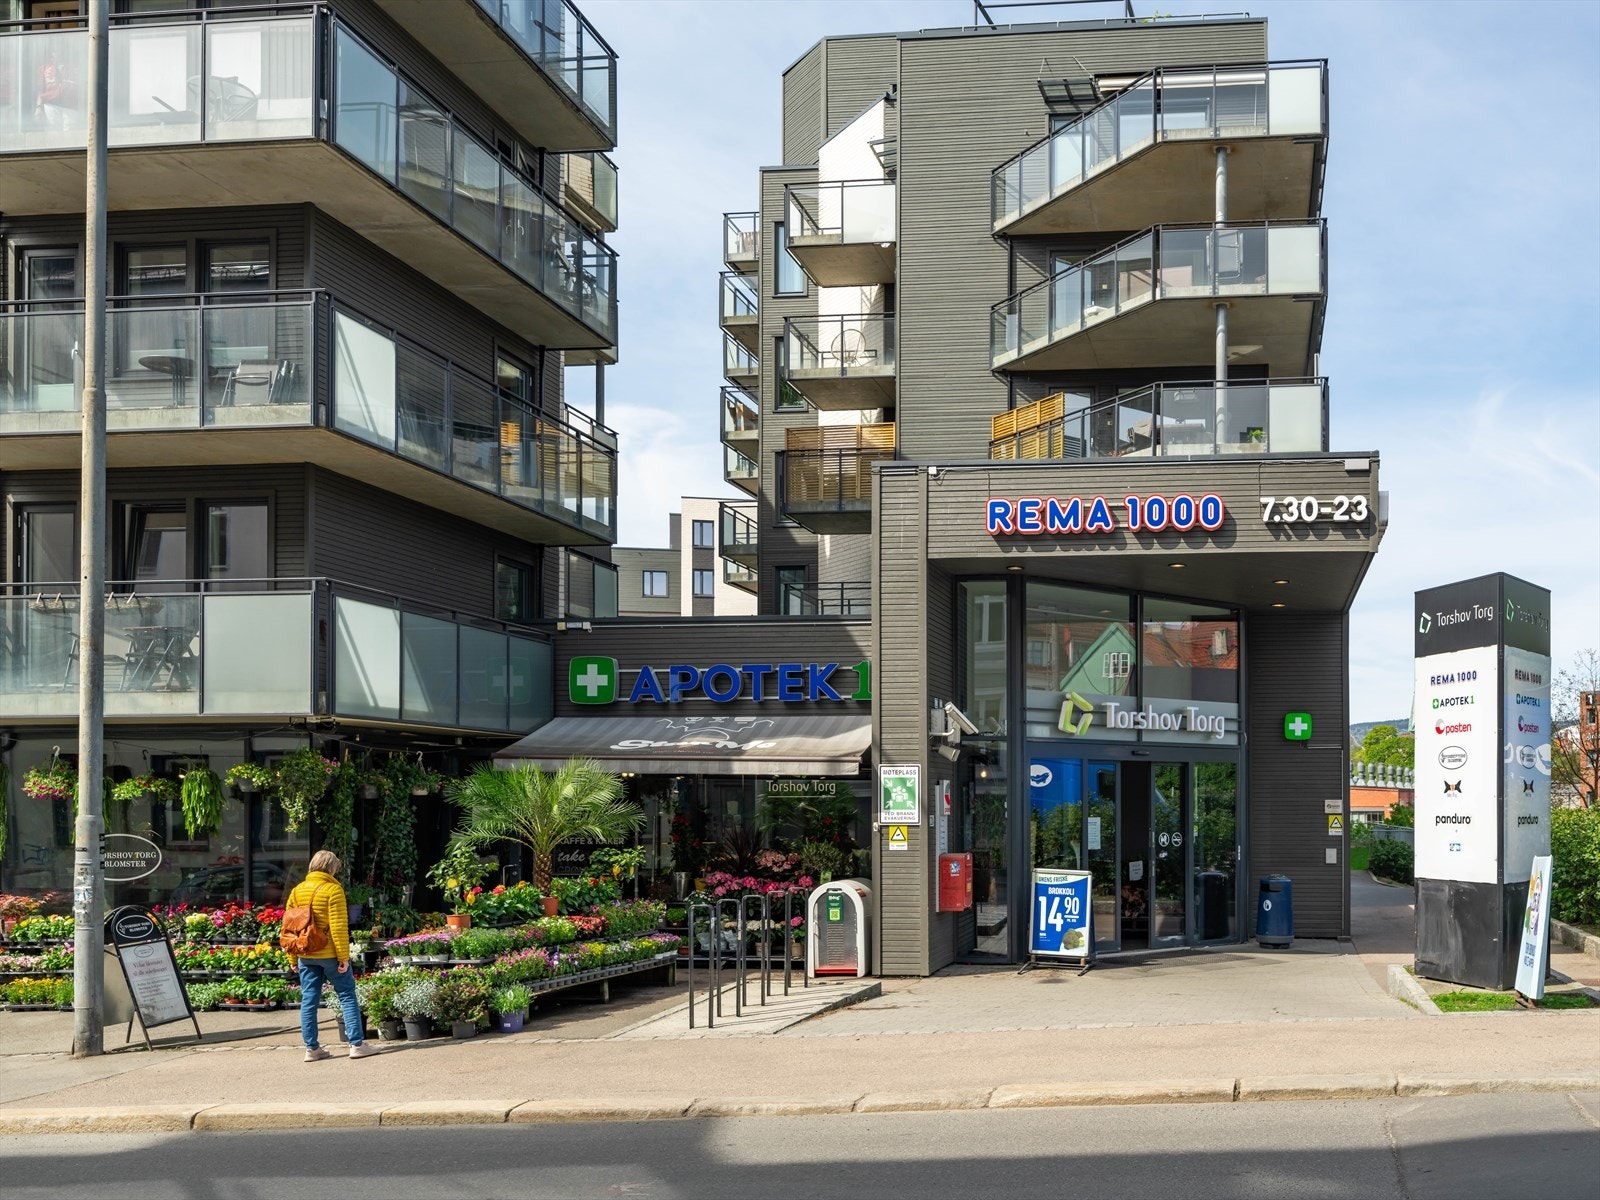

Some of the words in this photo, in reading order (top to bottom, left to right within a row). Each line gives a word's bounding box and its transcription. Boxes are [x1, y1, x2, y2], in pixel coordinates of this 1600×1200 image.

[985, 496, 1114, 535] REMA
[1124, 492, 1224, 533] 1000
[1260, 495, 1369, 522] 7.30-23
[1436, 609, 1472, 627] Torshov
[1473, 604, 1494, 622] Torg
[628, 662, 848, 703] APOTEK
[851, 660, 872, 701] 1
[1430, 674, 1455, 686] REMA
[1457, 670, 1477, 682] 1000
[1514, 668, 1530, 682] REMA
[1530, 673, 1542, 686] 1000
[1439, 696, 1469, 707] APOTEK
[1470, 695, 1475, 704] 1
[1520, 695, 1537, 707] APOTEK
[1102, 702, 1183, 731] Torshov
[1186, 706, 1225, 739] Torg
[1445, 722, 1472, 736] posten
[1523, 723, 1539, 733] posten
[766, 780, 810, 792] Torshov
[812, 780, 836, 795] Torg
[1435, 813, 1471, 826] panduro
[1517, 814, 1539, 828] panduro
[134, 851, 157, 859] TORG
[557, 849, 586, 862] take
[1048, 887, 1075, 895] BROKKOLI
